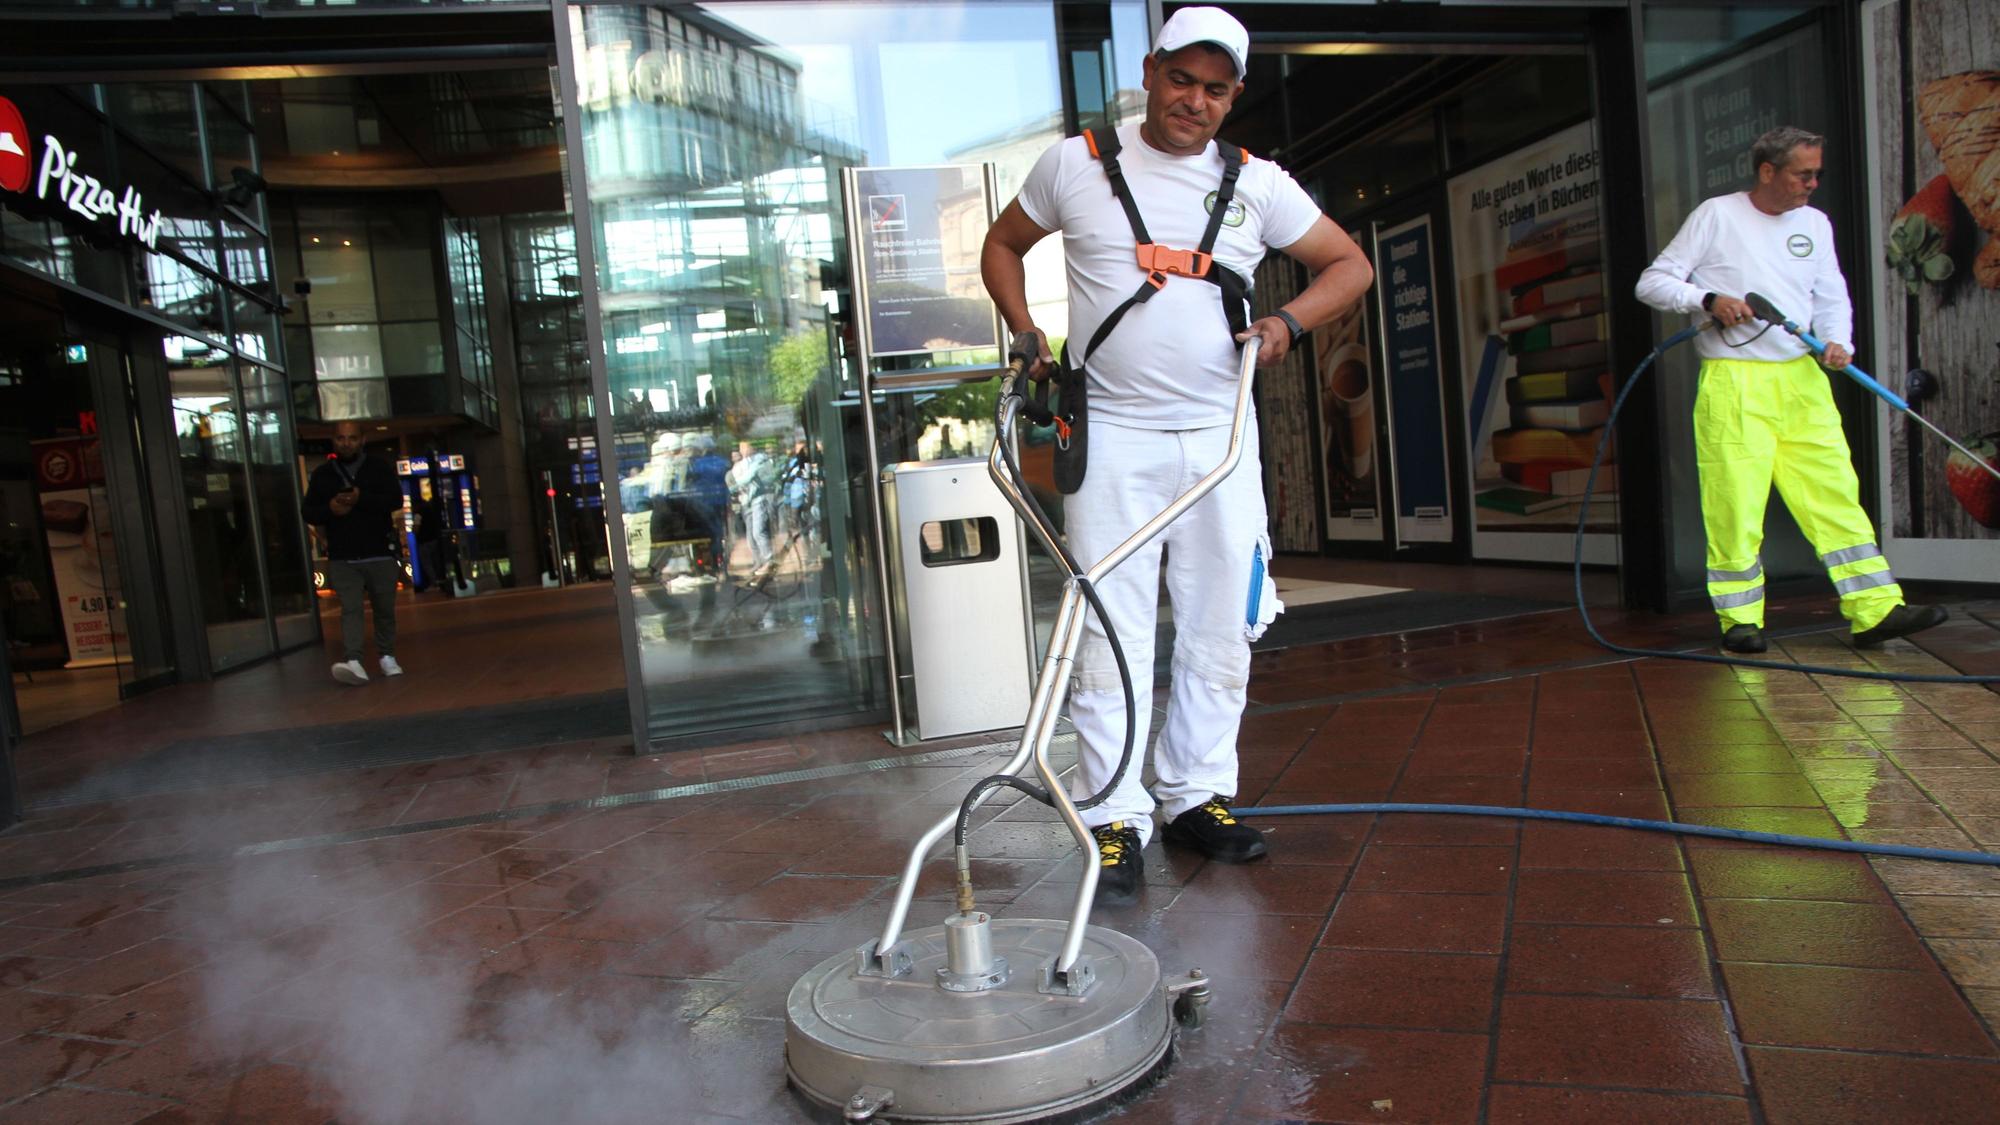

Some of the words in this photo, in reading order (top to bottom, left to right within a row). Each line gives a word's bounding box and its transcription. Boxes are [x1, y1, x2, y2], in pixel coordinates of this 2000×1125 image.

[1702, 88, 1751, 120] Wenn
[1704, 126, 1730, 155] Sie
[1733, 107, 1778, 145] nicht
[1471, 187, 1492, 212] Alle
[1493, 178, 1525, 209] guten
[1525, 162, 1563, 191] Worte
[1706, 162, 1732, 189] am
[1734, 150, 1755, 179] Gl
[38, 134, 118, 221] Pizza
[118, 185, 164, 250] Hut
[1497, 201, 1536, 230] stehen
[1537, 194, 1550, 216] in
[1392, 264, 1407, 286] die
[1394, 283, 1428, 309] richtige
[1395, 308, 1431, 332] Station:
